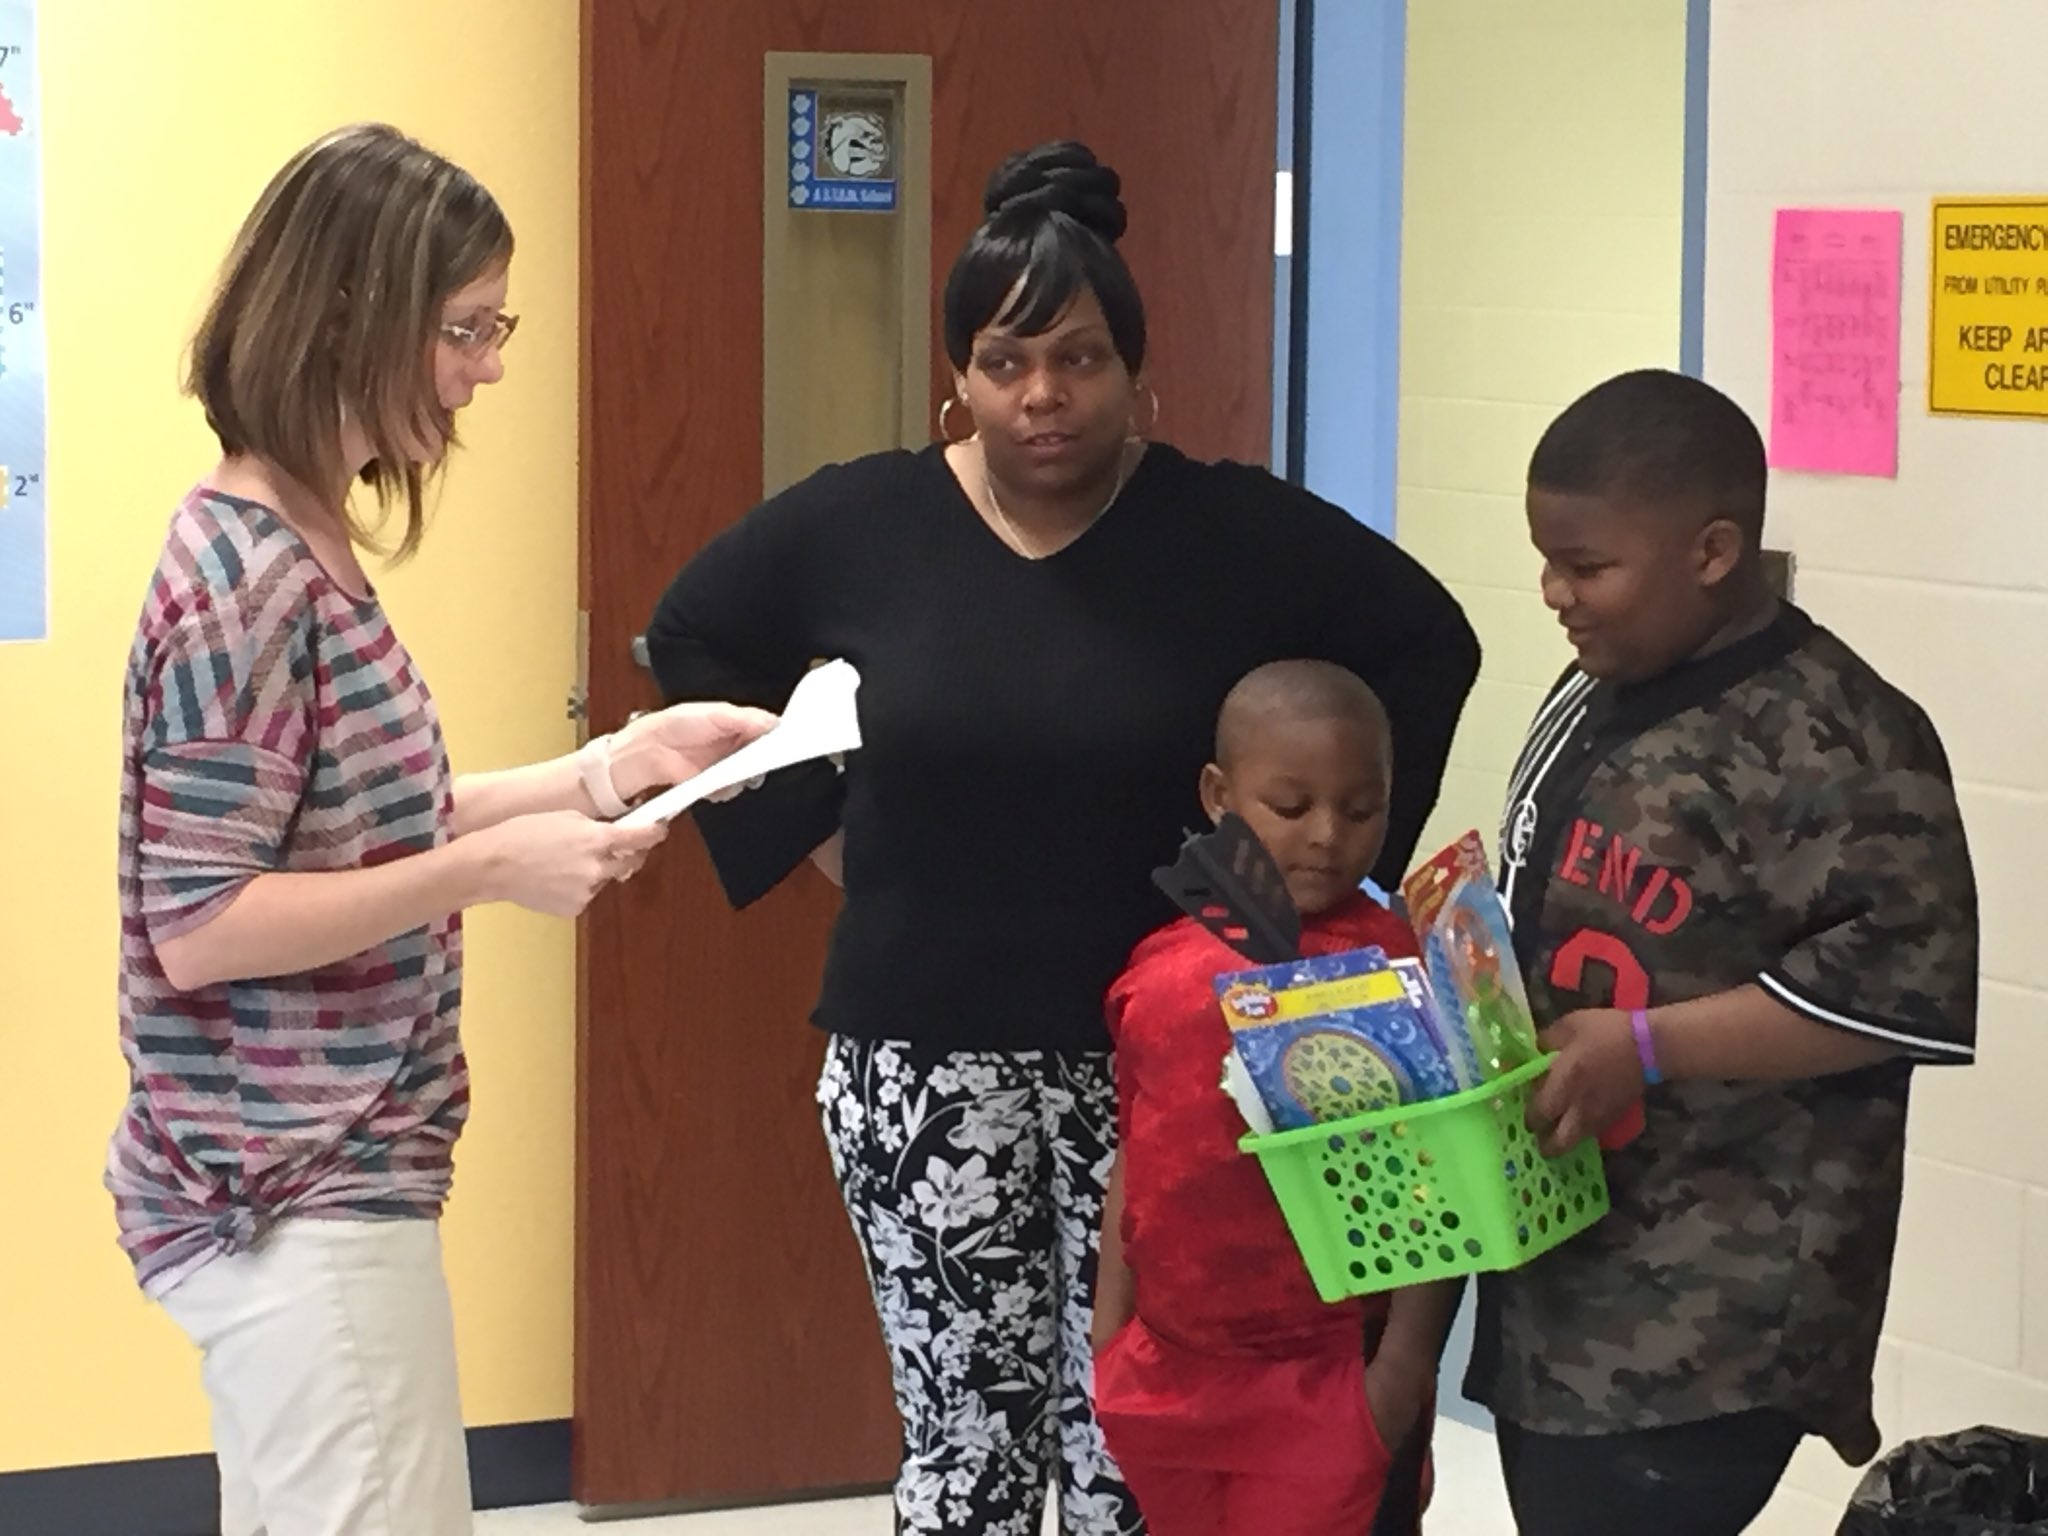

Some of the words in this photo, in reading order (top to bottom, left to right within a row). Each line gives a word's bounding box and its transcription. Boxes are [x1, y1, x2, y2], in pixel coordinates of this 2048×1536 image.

[1944, 275, 1978, 295] FROM
[1984, 276, 2029, 296] UTILITY
[1959, 325, 2012, 352] KEEP
[1559, 817, 1693, 935] END
